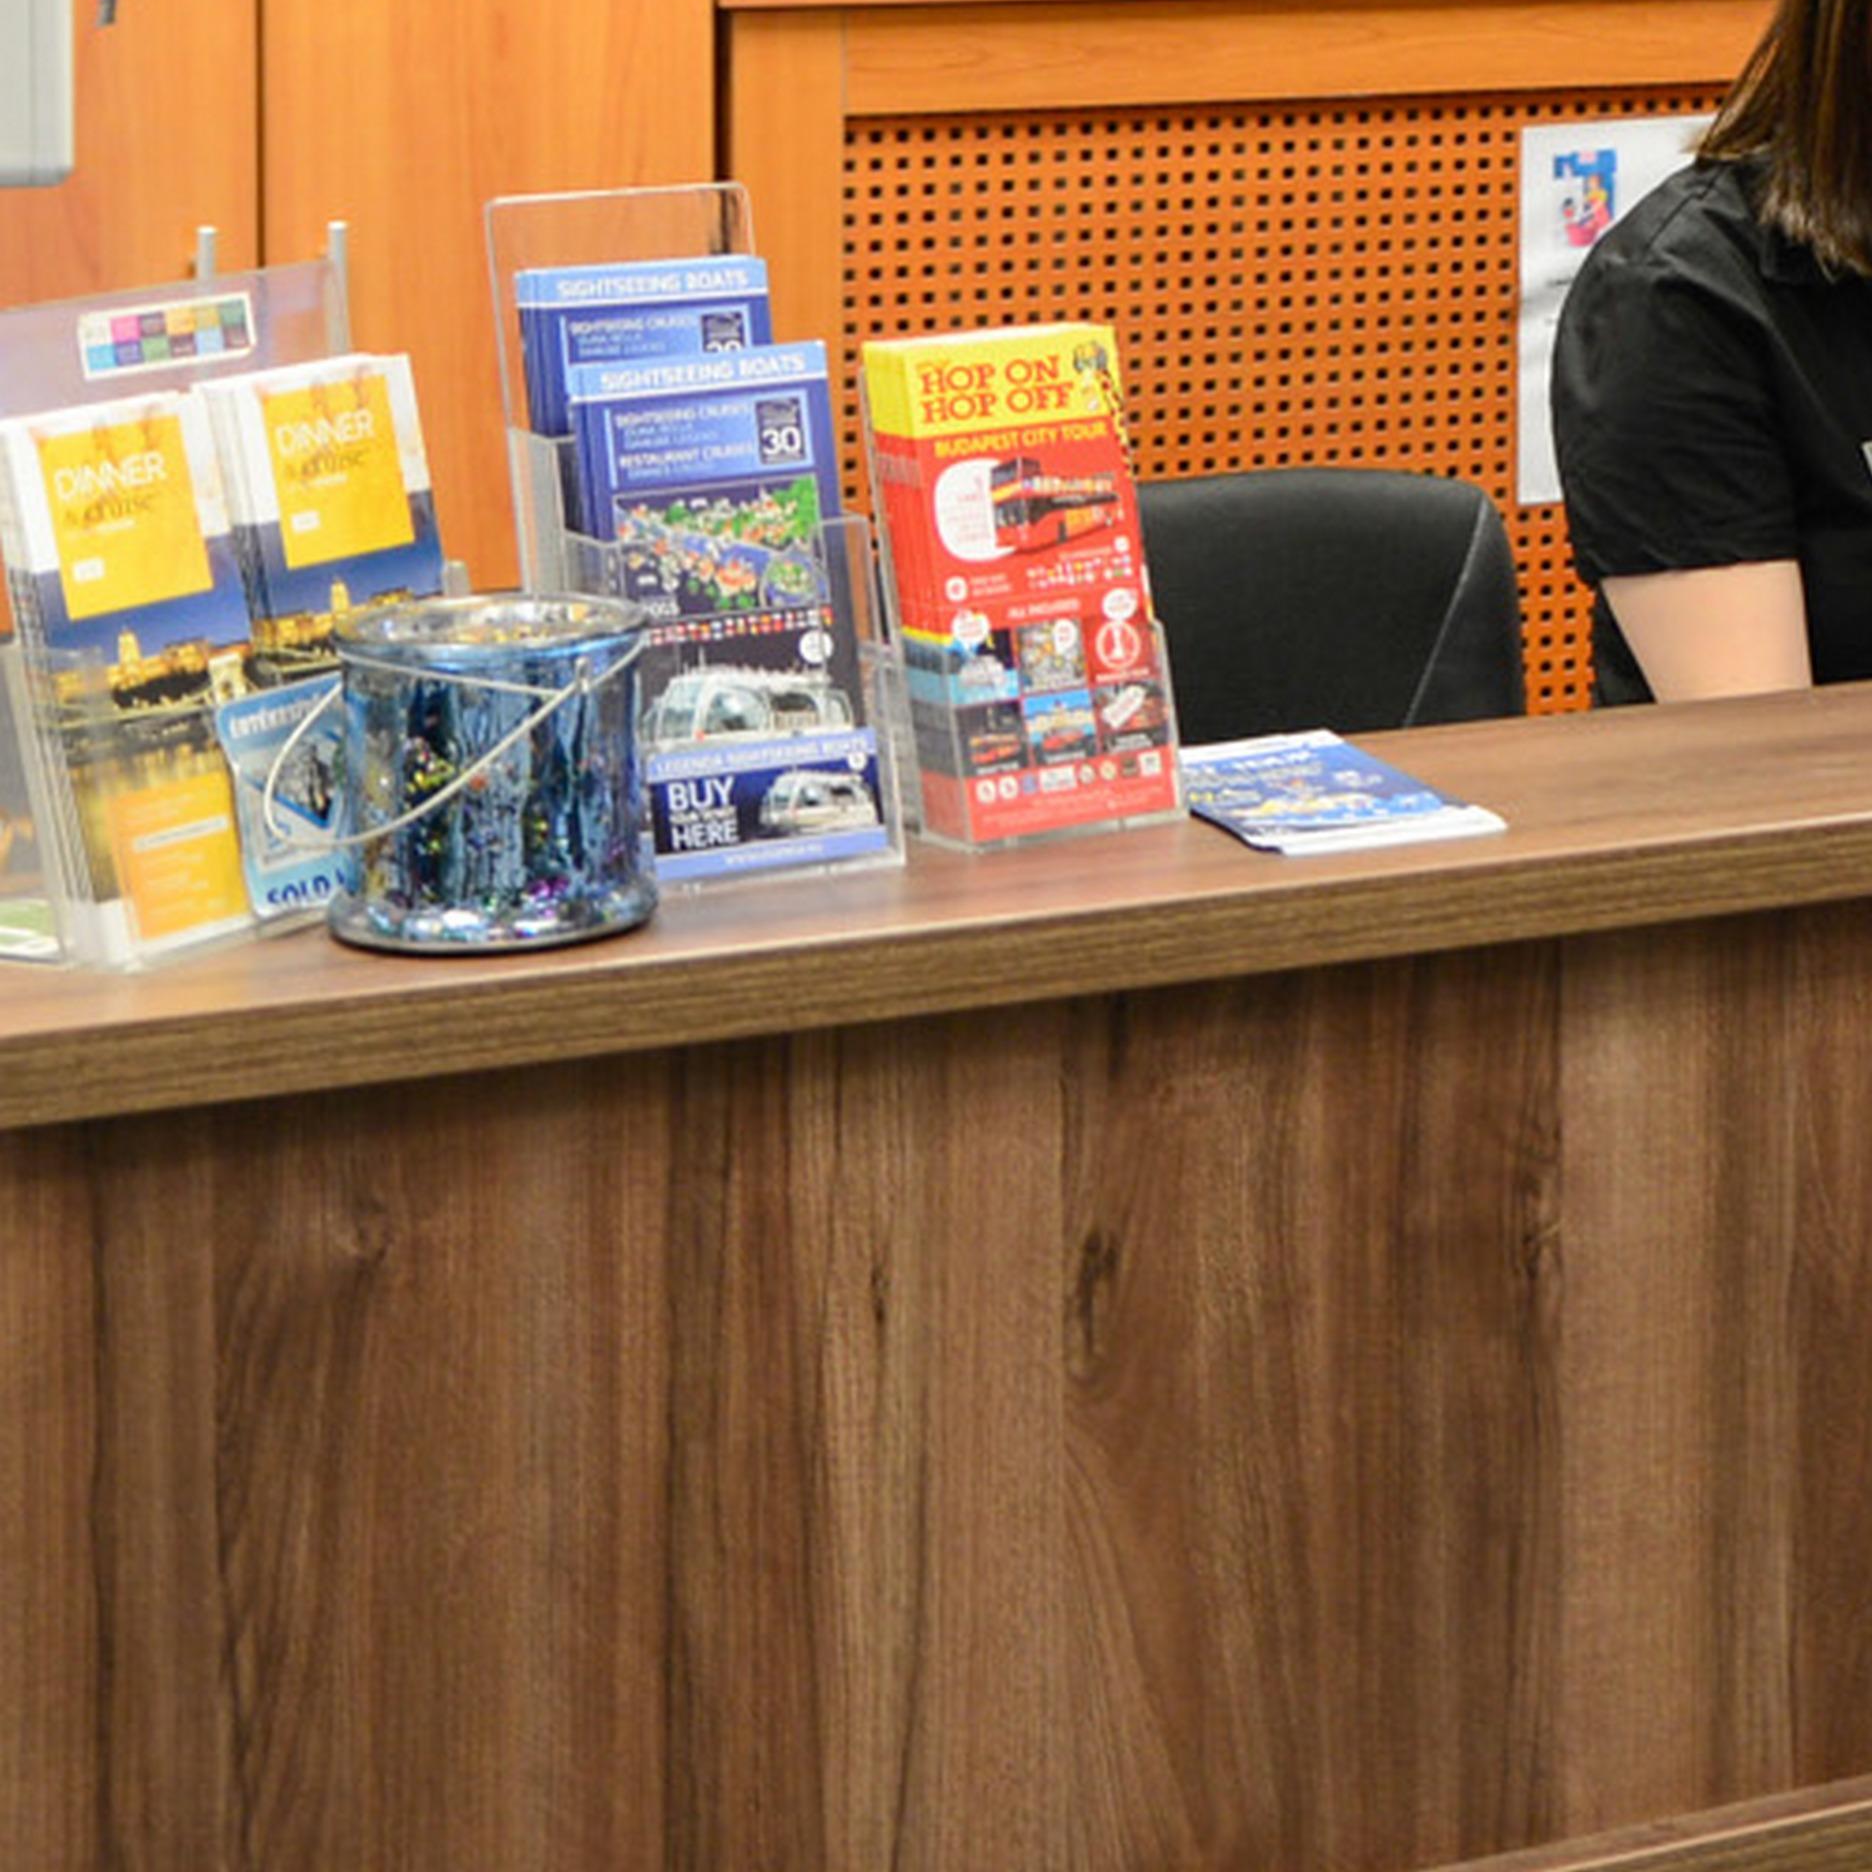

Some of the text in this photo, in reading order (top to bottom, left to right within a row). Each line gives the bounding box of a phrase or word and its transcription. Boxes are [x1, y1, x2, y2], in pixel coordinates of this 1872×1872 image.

[558, 270, 749, 296] SIGHTSEEING BOATS
[603, 354, 805, 388] SIGHTSEEING BOATS
[921, 363, 995, 395] HOP
[1005, 356, 1059, 384] ON
[921, 381, 1074, 424] HOP OFF
[274, 408, 376, 459] DINNER
[762, 425, 802, 455] 30
[934, 422, 1107, 458] BUDAPEST CITY TOUR
[54, 450, 168, 503] DINNER
[667, 776, 735, 812] BUY
[671, 821, 739, 850] HERE
